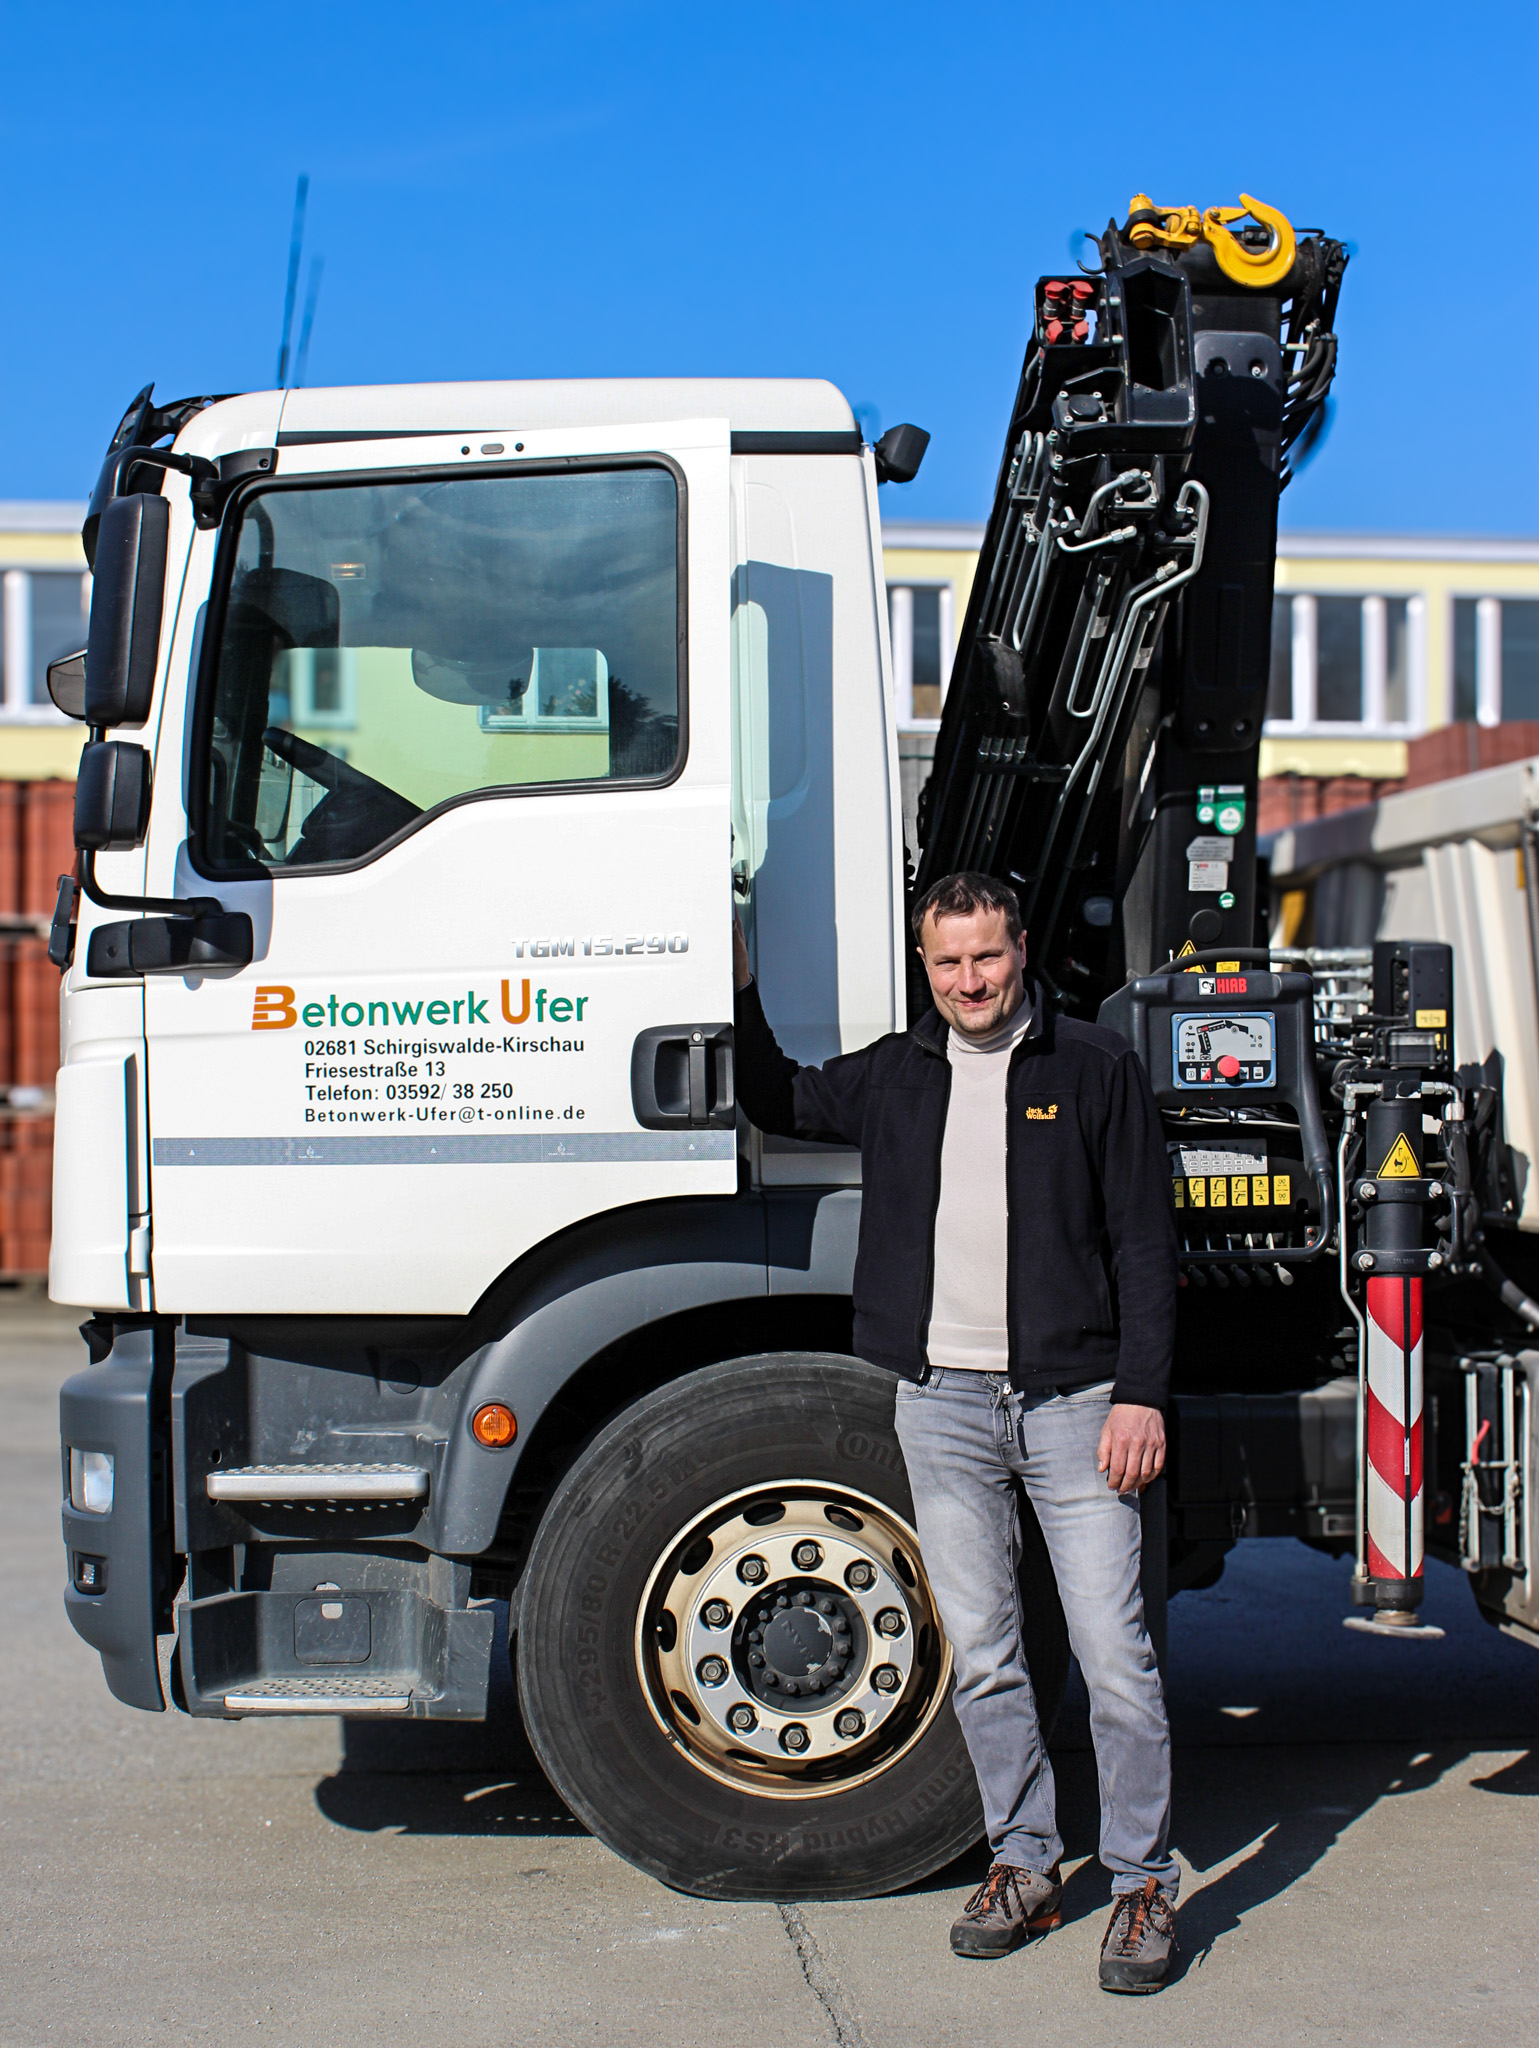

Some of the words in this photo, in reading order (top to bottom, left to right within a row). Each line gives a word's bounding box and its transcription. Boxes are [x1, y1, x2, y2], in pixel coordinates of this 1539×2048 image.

[510, 936, 575, 958] TGM
[581, 932, 689, 956] 15.290
[1216, 977, 1247, 994] HIAB
[251, 985, 490, 1030] Betonwerk
[501, 979, 589, 1024] Ufer
[304, 1040, 356, 1056] 02681
[364, 1036, 585, 1058] Schirgiswalde-Kirschau
[305, 1061, 418, 1078] Friesestraße
[425, 1061, 446, 1077] 13
[305, 1084, 379, 1101] Telefon:
[386, 1083, 447, 1101] 03592/
[453, 1083, 474, 1099] 38
[480, 1083, 514, 1099] 250
[304, 1104, 586, 1123] Betonwerk-Ufer@t-online.de
[1026, 1106, 1043, 1114] Jack
[1026, 1112, 1056, 1120] Wolfskin
[576, 1572, 609, 1690] 295/80
[594, 1543, 621, 1570] R
[612, 1480, 667, 1542] 22.5
[802, 1808, 907, 1856] Hybrid
